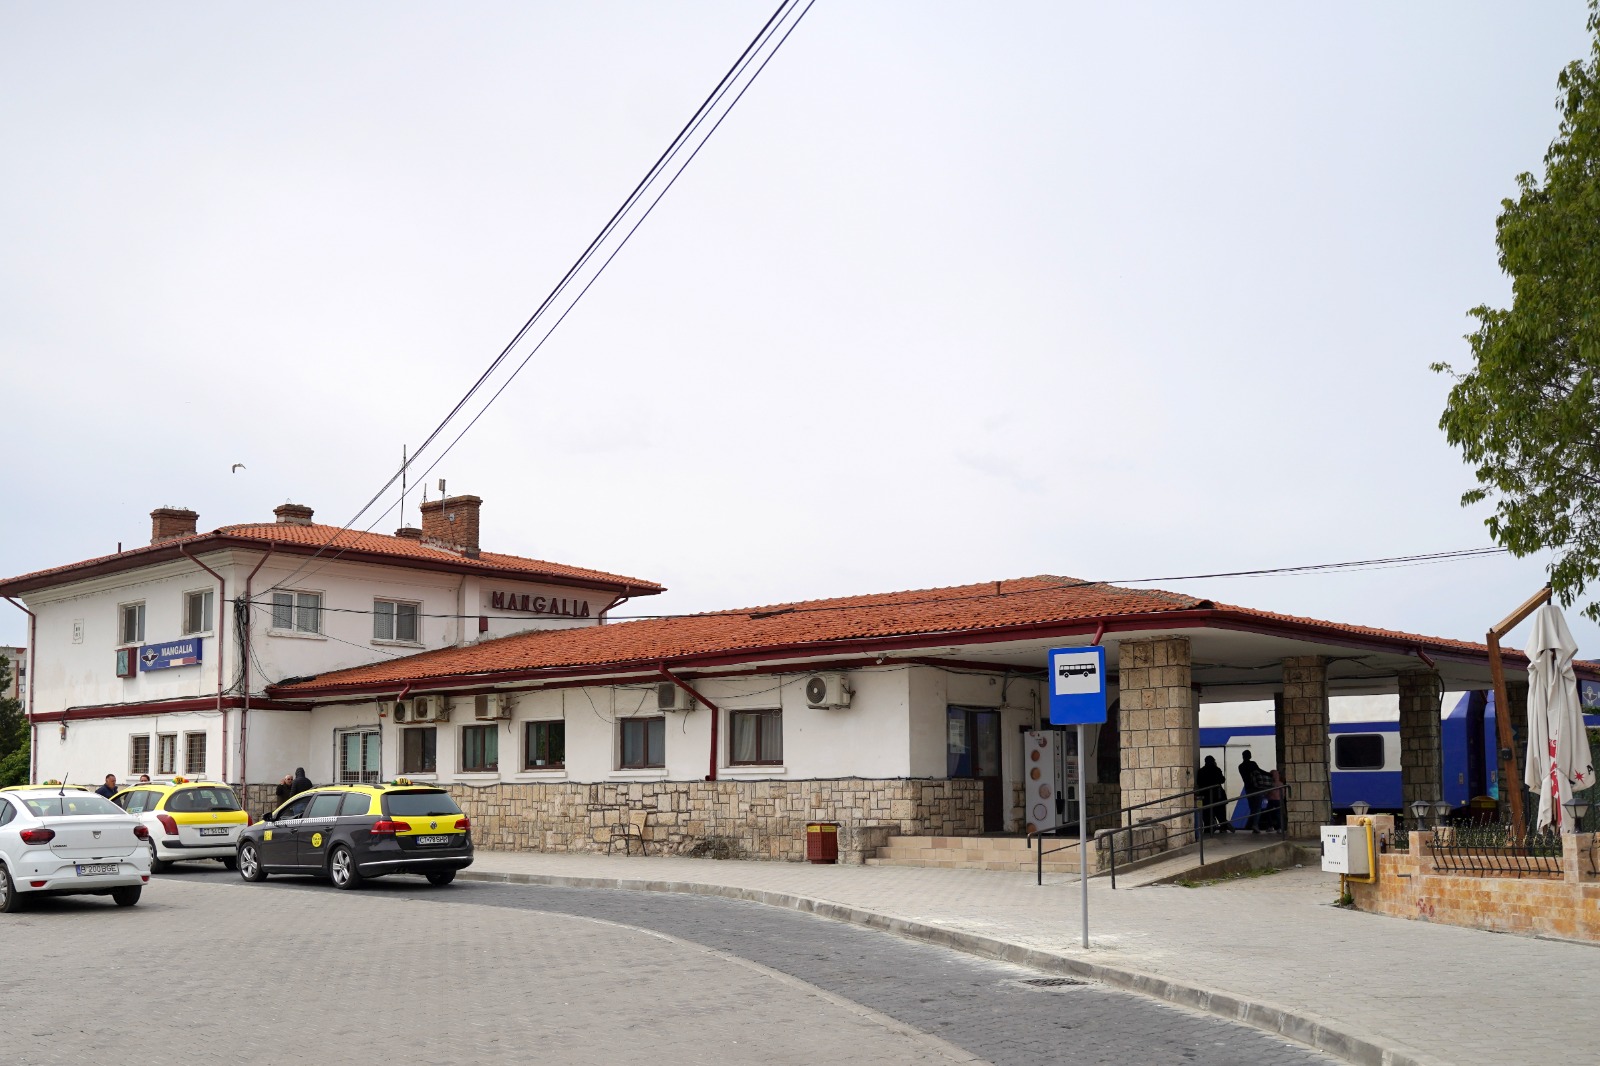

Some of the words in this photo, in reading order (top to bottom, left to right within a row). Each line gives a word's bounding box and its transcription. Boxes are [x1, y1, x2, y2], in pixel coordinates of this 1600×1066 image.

[492, 591, 590, 617] MANGALIA
[161, 644, 193, 656] MANGALIA
[81, 865, 86, 873] B
